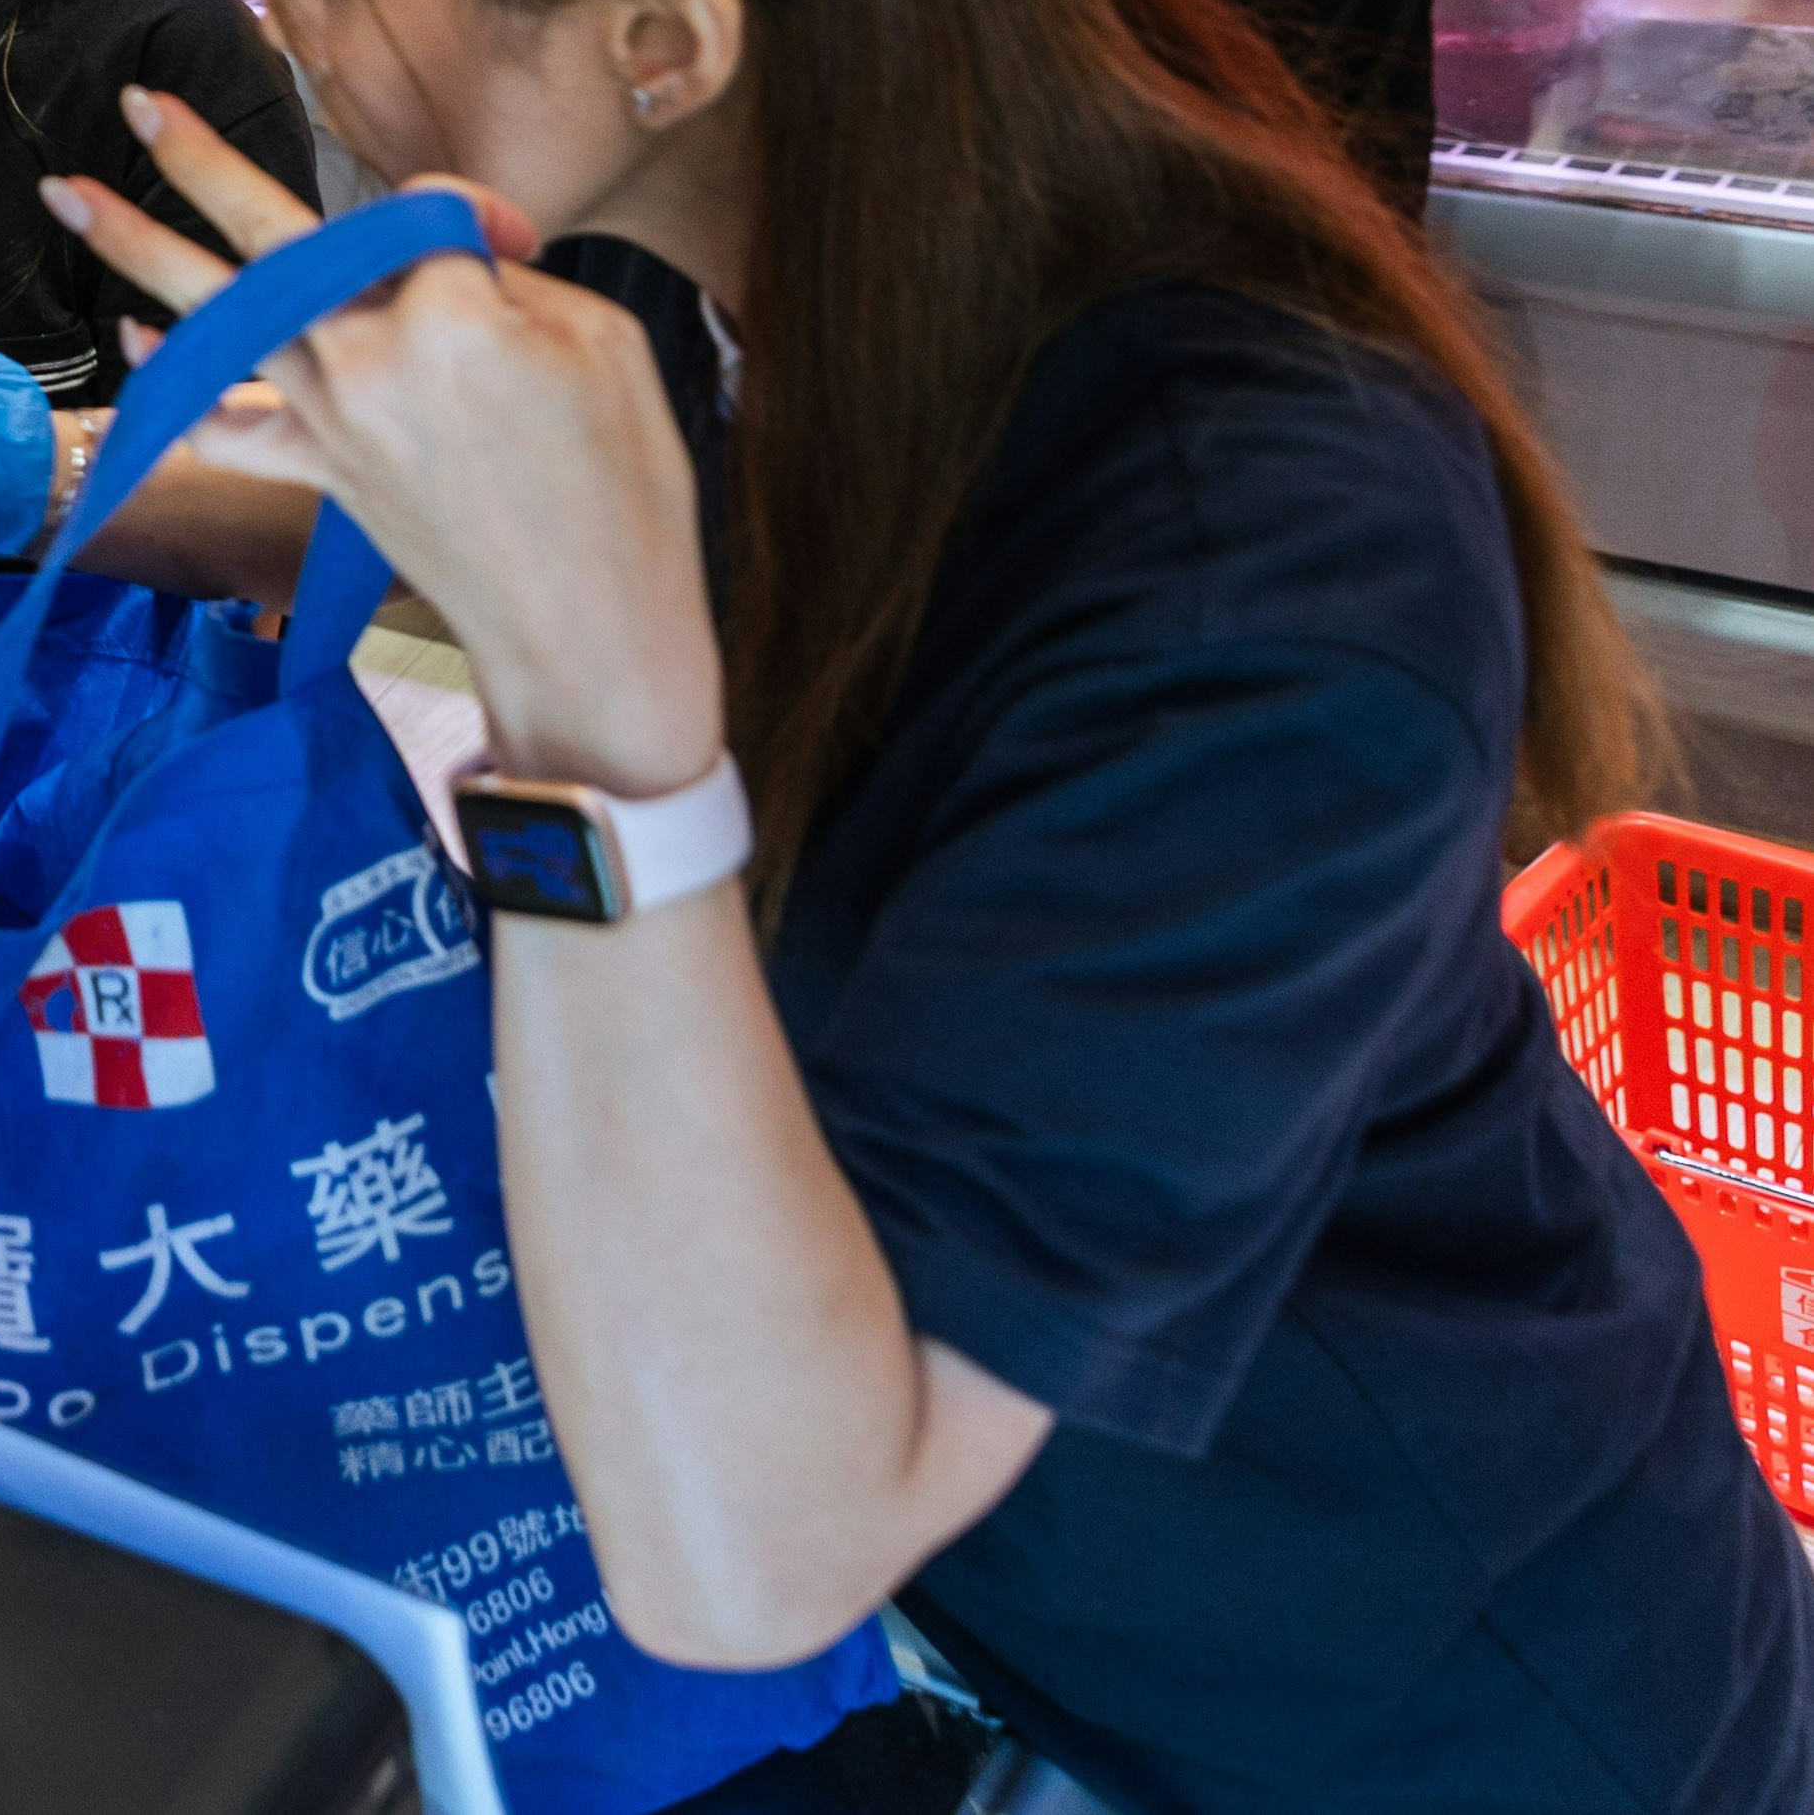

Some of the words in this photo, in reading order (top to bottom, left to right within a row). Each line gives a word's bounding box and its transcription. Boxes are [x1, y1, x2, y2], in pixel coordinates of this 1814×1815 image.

[326, 908, 414, 985] 信心
[139, 1246, 511, 1394] Dispens
[330, 1356, 543, 1440] 藥師主
[337, 1424, 555, 1487] 精心配
[485, 1661, 596, 1742] 96806
